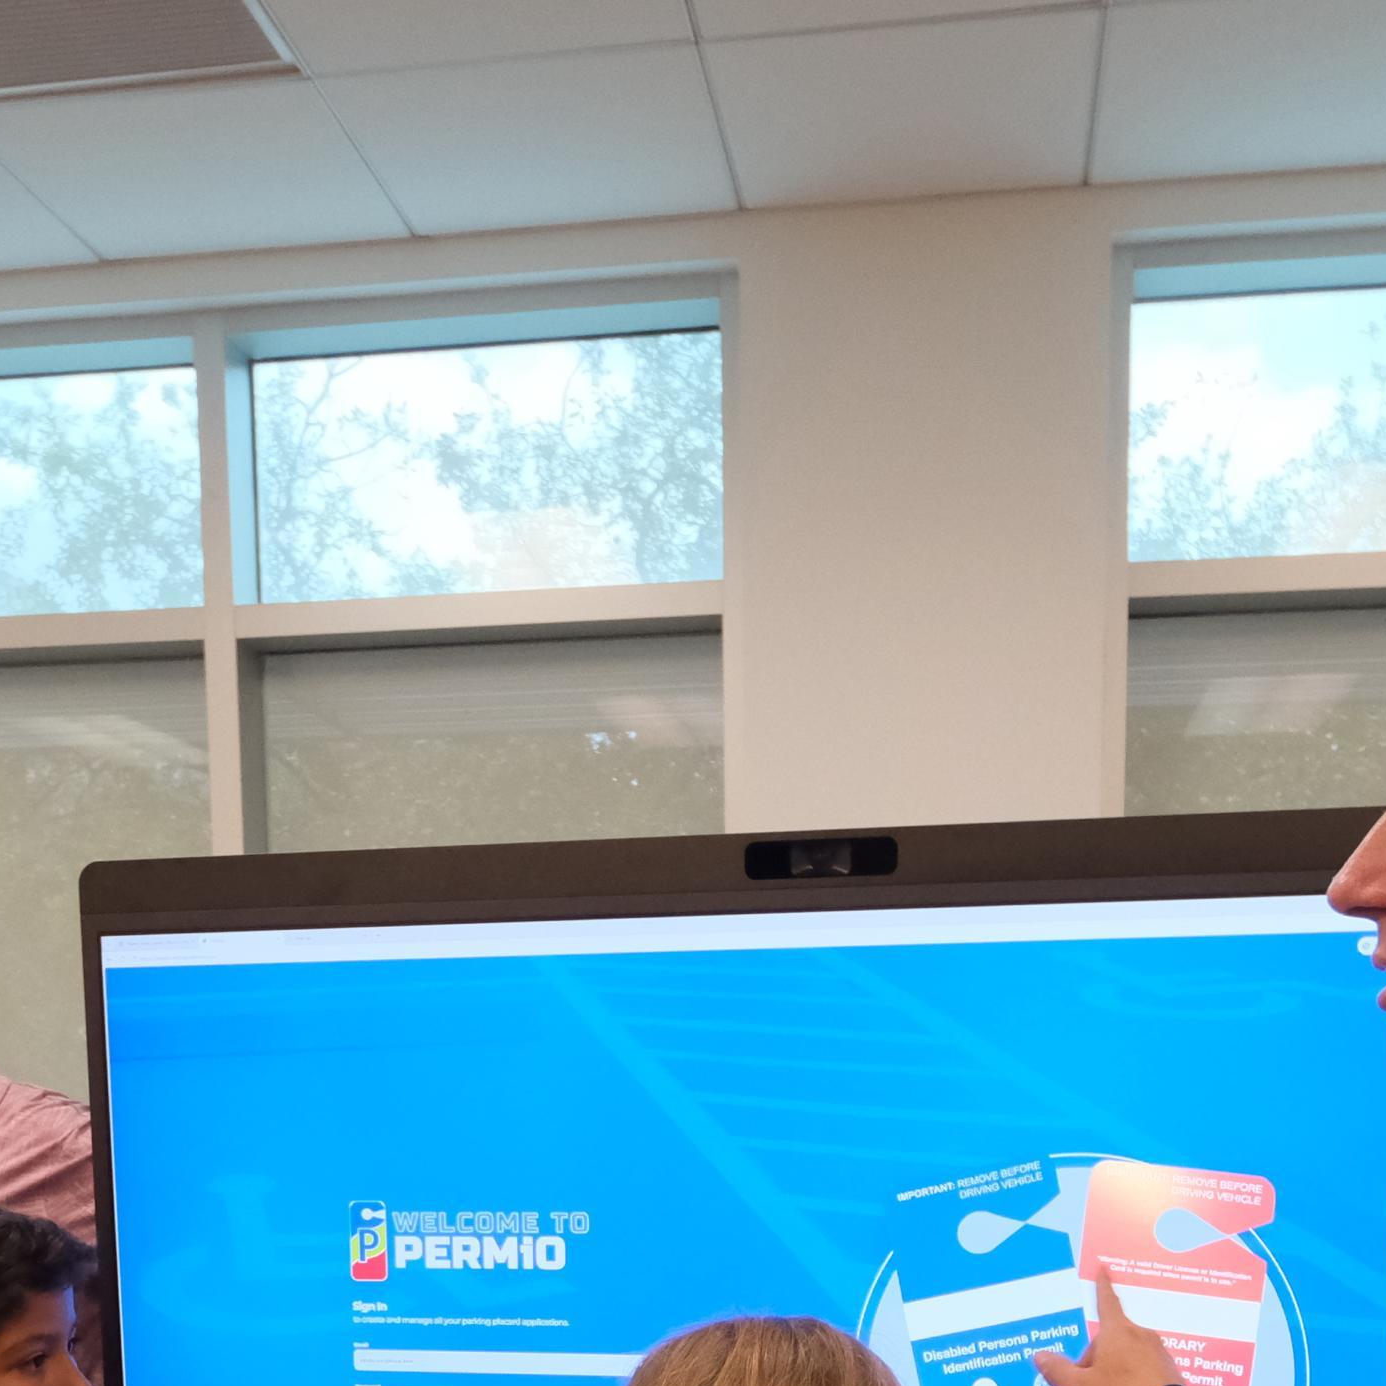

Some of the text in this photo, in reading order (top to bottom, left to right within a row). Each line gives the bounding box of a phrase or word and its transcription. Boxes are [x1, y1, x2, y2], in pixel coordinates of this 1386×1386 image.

[957, 1171, 999, 1189] REMOVE
[1000, 1160, 1041, 1179] BEFORE
[959, 1171, 1044, 1199] DRIVING VEHICLE
[1172, 1174, 1263, 1195] REMOVE BEFORE
[1217, 1192, 1262, 1207] VEHICLE
[392, 1211, 590, 1235] WELCOME TO
[352, 1300, 376, 1313] Sign
[923, 1324, 1080, 1363] Disabled Persons Parking
[943, 1352, 1022, 1375] Identification
[1194, 1357, 1245, 1376] Parking
